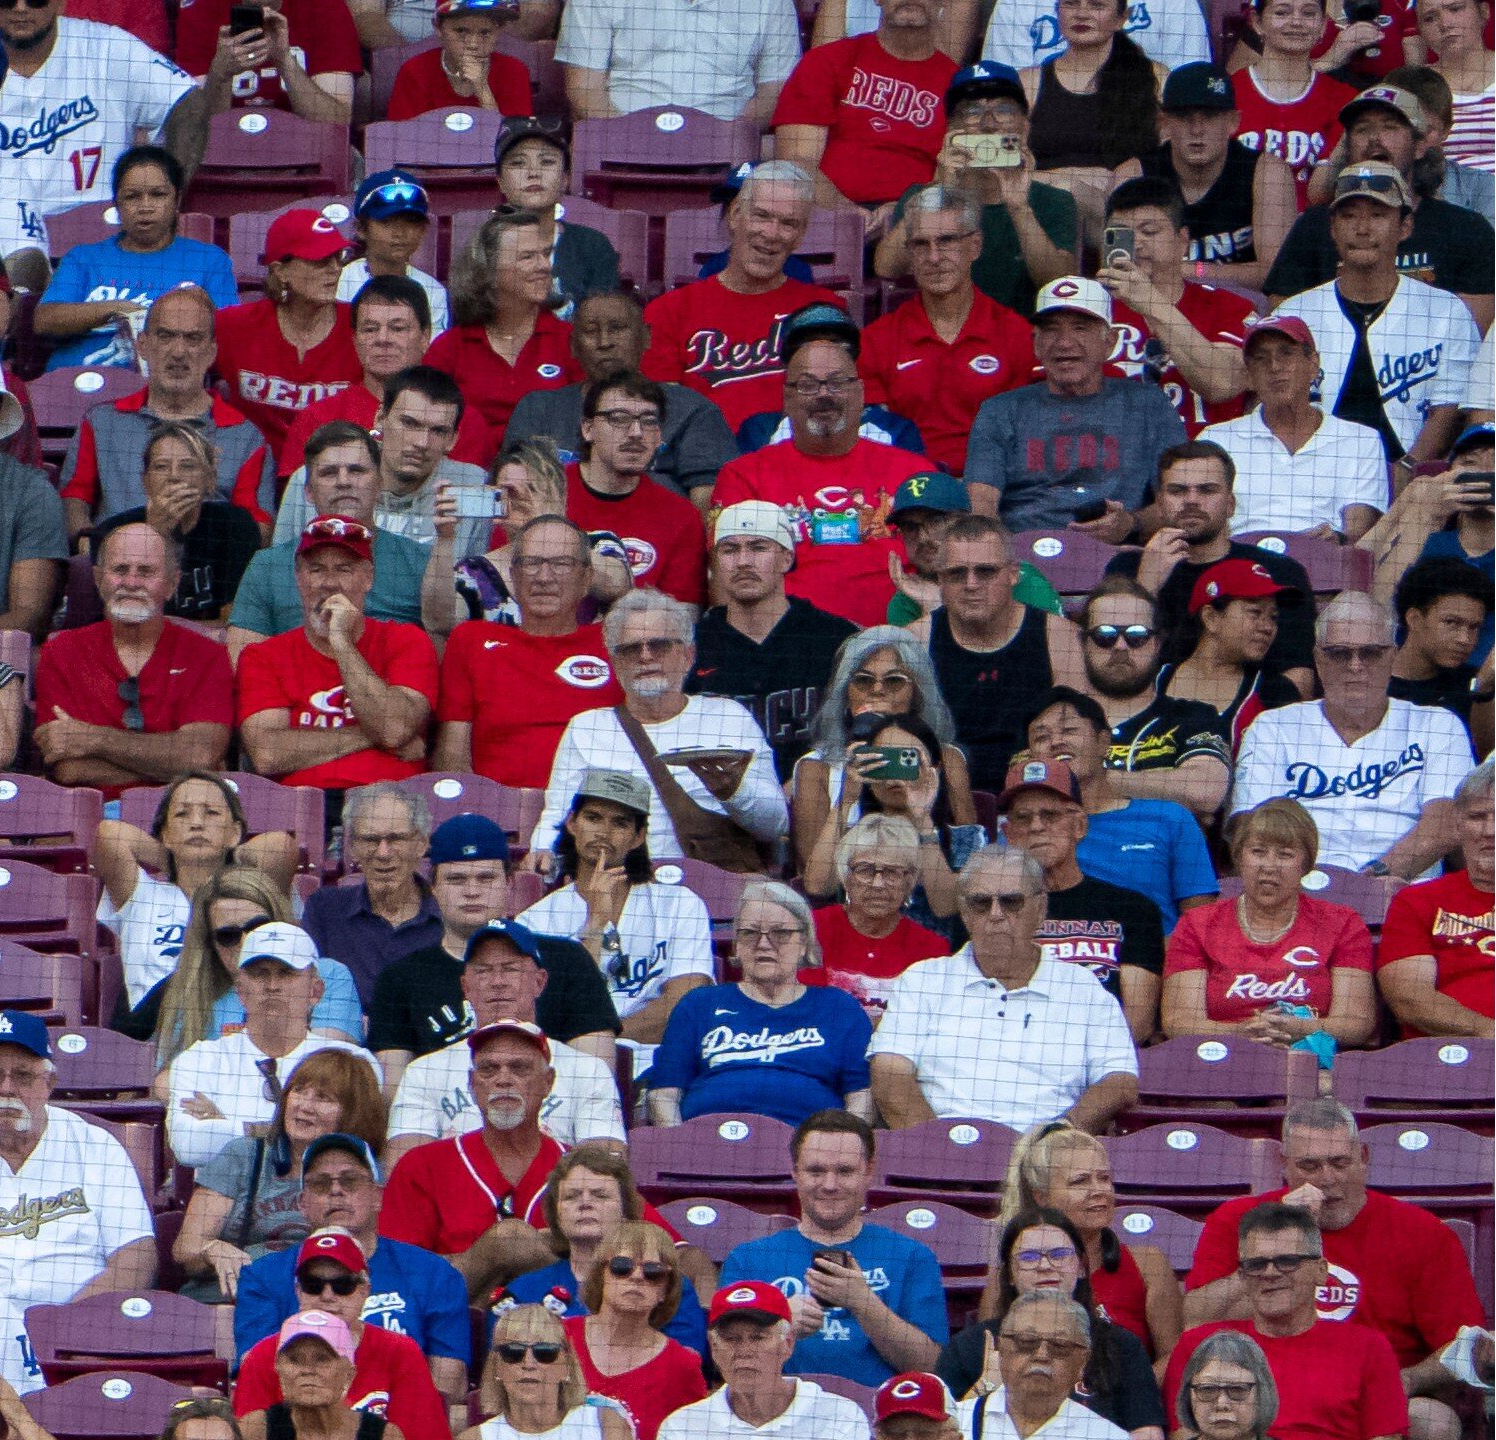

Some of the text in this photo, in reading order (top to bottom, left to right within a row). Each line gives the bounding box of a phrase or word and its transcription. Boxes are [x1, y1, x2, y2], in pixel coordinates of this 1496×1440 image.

[841, 67, 941, 129] REDS
[68, 146, 103, 191] 17
[16, 198, 44, 239] LA
[311, 217, 335, 232] C
[1050, 280, 1080, 298] C
[685, 317, 784, 386] Red
[1025, 433, 1122, 472] REDS
[813, 485, 849, 508] C
[1285, 742, 1425, 800] Dodgers
[1282, 945, 1321, 967] C
[1225, 973, 1312, 1001] Reds
[701, 1024, 825, 1069] Dodgers
[1314, 1285, 1360, 1304] EDS
[298, 1311, 329, 1326] C
[821, 1310, 851, 1341] LA
[890, 1380, 921, 1398] C
